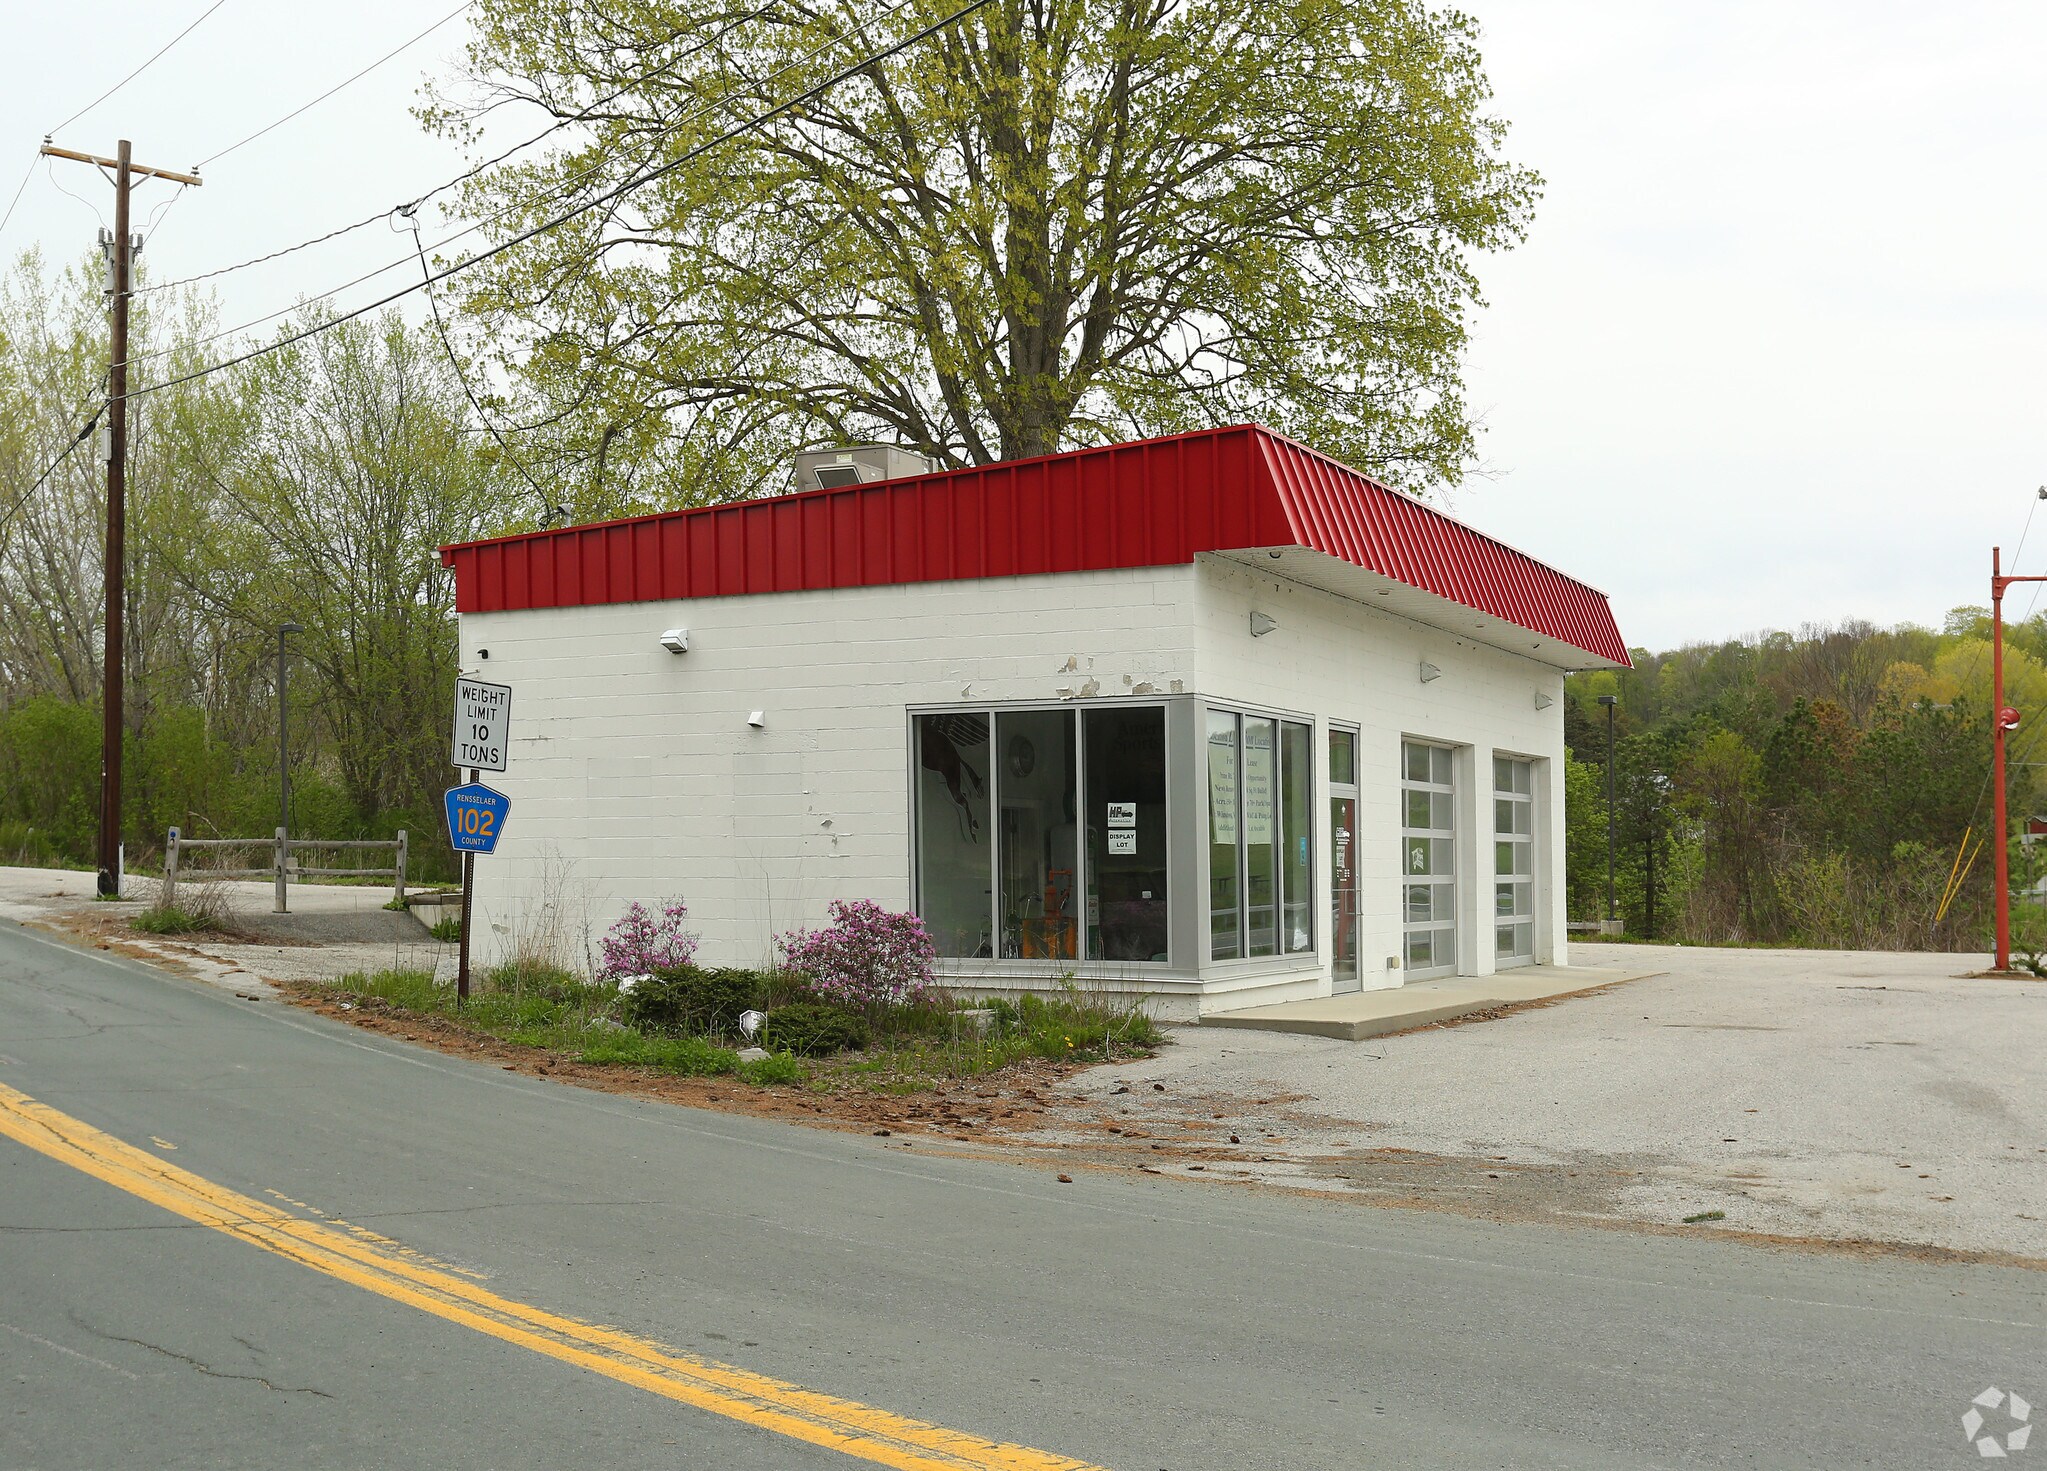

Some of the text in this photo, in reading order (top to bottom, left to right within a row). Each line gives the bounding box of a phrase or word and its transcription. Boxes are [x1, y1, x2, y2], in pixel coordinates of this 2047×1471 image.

[462, 686, 506, 706] WEIGHT
[467, 704, 498, 721] LIMIT
[472, 724, 489, 741] 10
[461, 743, 499, 764] TONS
[456, 793, 497, 806] RENSSELAER
[457, 807, 494, 837] 102
[461, 836, 487, 846] COUNTY
